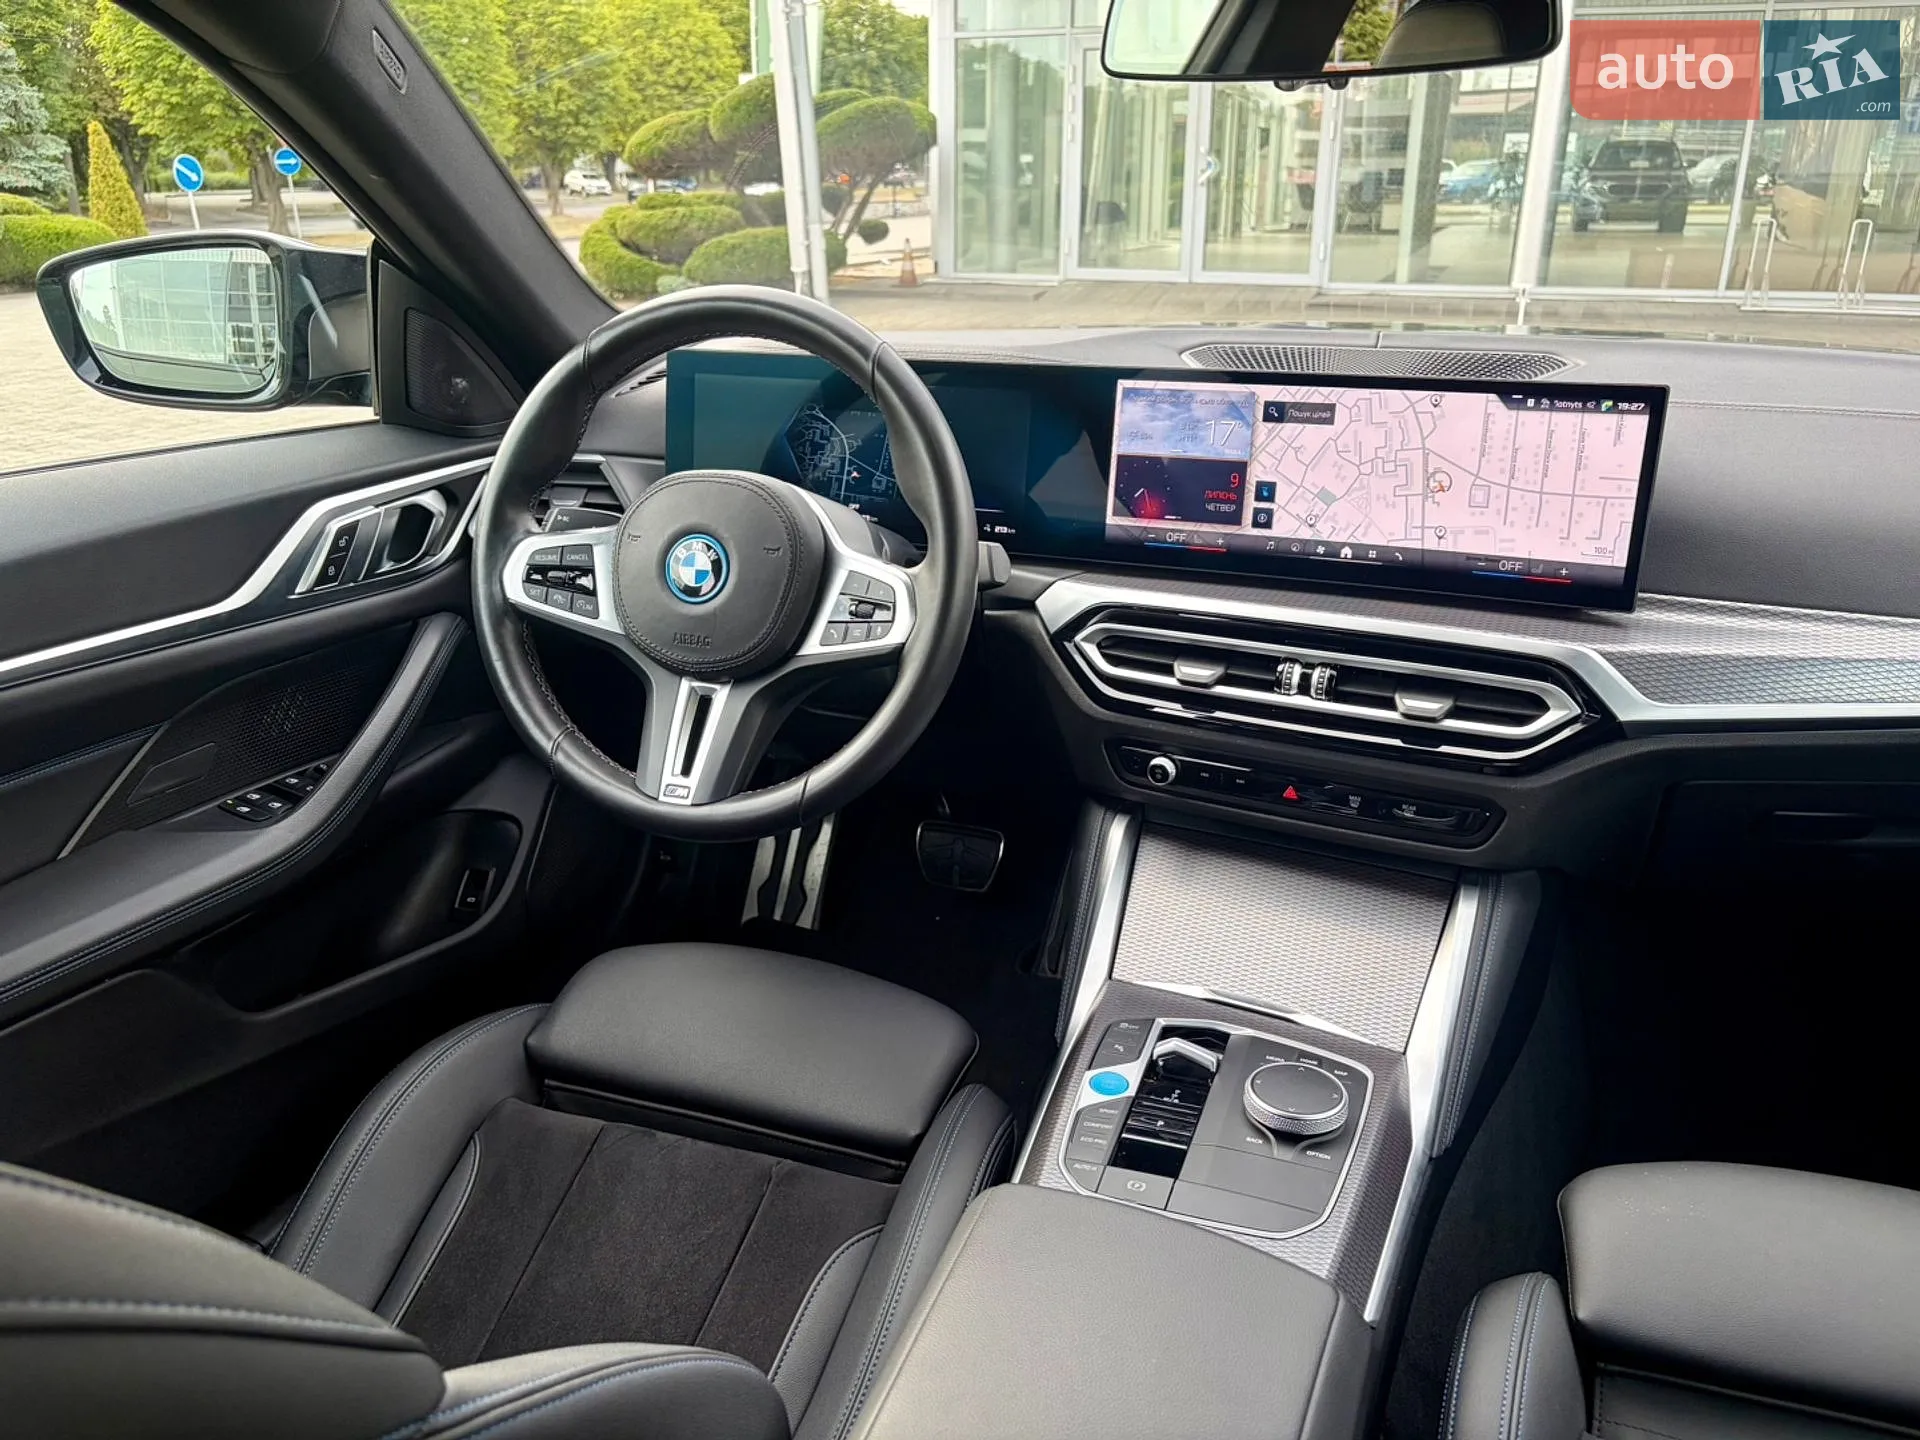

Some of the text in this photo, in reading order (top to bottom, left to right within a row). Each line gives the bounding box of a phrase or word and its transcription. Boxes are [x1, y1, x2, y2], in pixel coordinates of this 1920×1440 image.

[1617, 402, 1645, 411] 19:27
[1230, 473, 1239, 488] 9
[1205, 502, 1236, 512] ЧЕТВЕР
[1165, 531, 1187, 542] OFF
[566, 553, 588, 561] CANCEL
[1498, 559, 1523, 572] OFF
[672, 631, 712, 649] AIRBAG
[1306, 1150, 1331, 1160] OPTION
